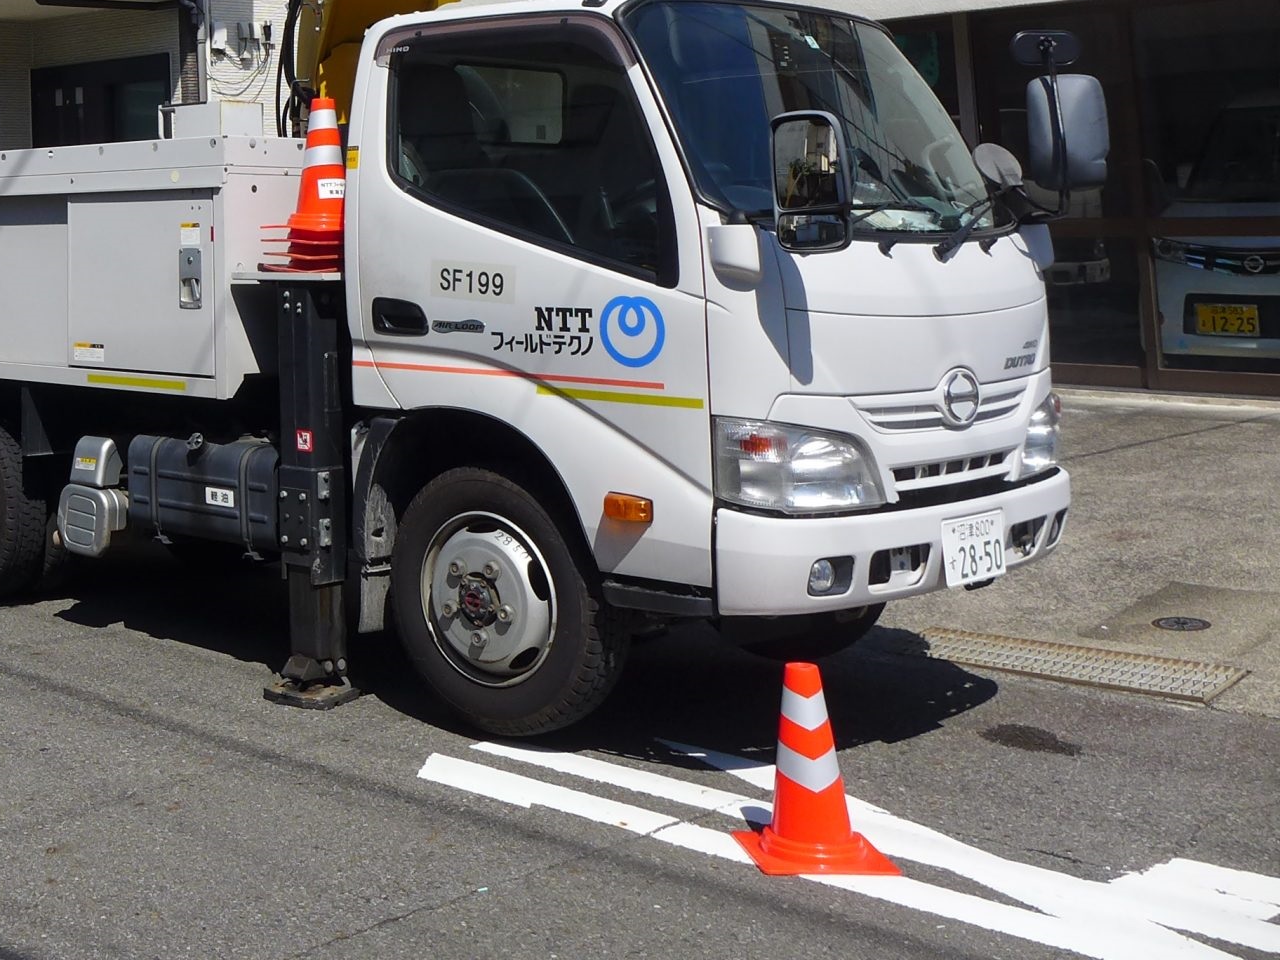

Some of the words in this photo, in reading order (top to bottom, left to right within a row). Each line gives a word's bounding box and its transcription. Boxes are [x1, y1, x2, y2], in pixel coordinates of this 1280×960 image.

[385, 45, 410, 53] HINO
[440, 268, 505, 296] SF199
[534, 306, 593, 333] NTT
[1212, 315, 1256, 333] 12-25
[491, 331, 593, 356] フィールドテクノ
[1003, 352, 1036, 370] DUTRO
[210, 490, 229, 504] 軽油
[958, 538, 1003, 579] 28-50
